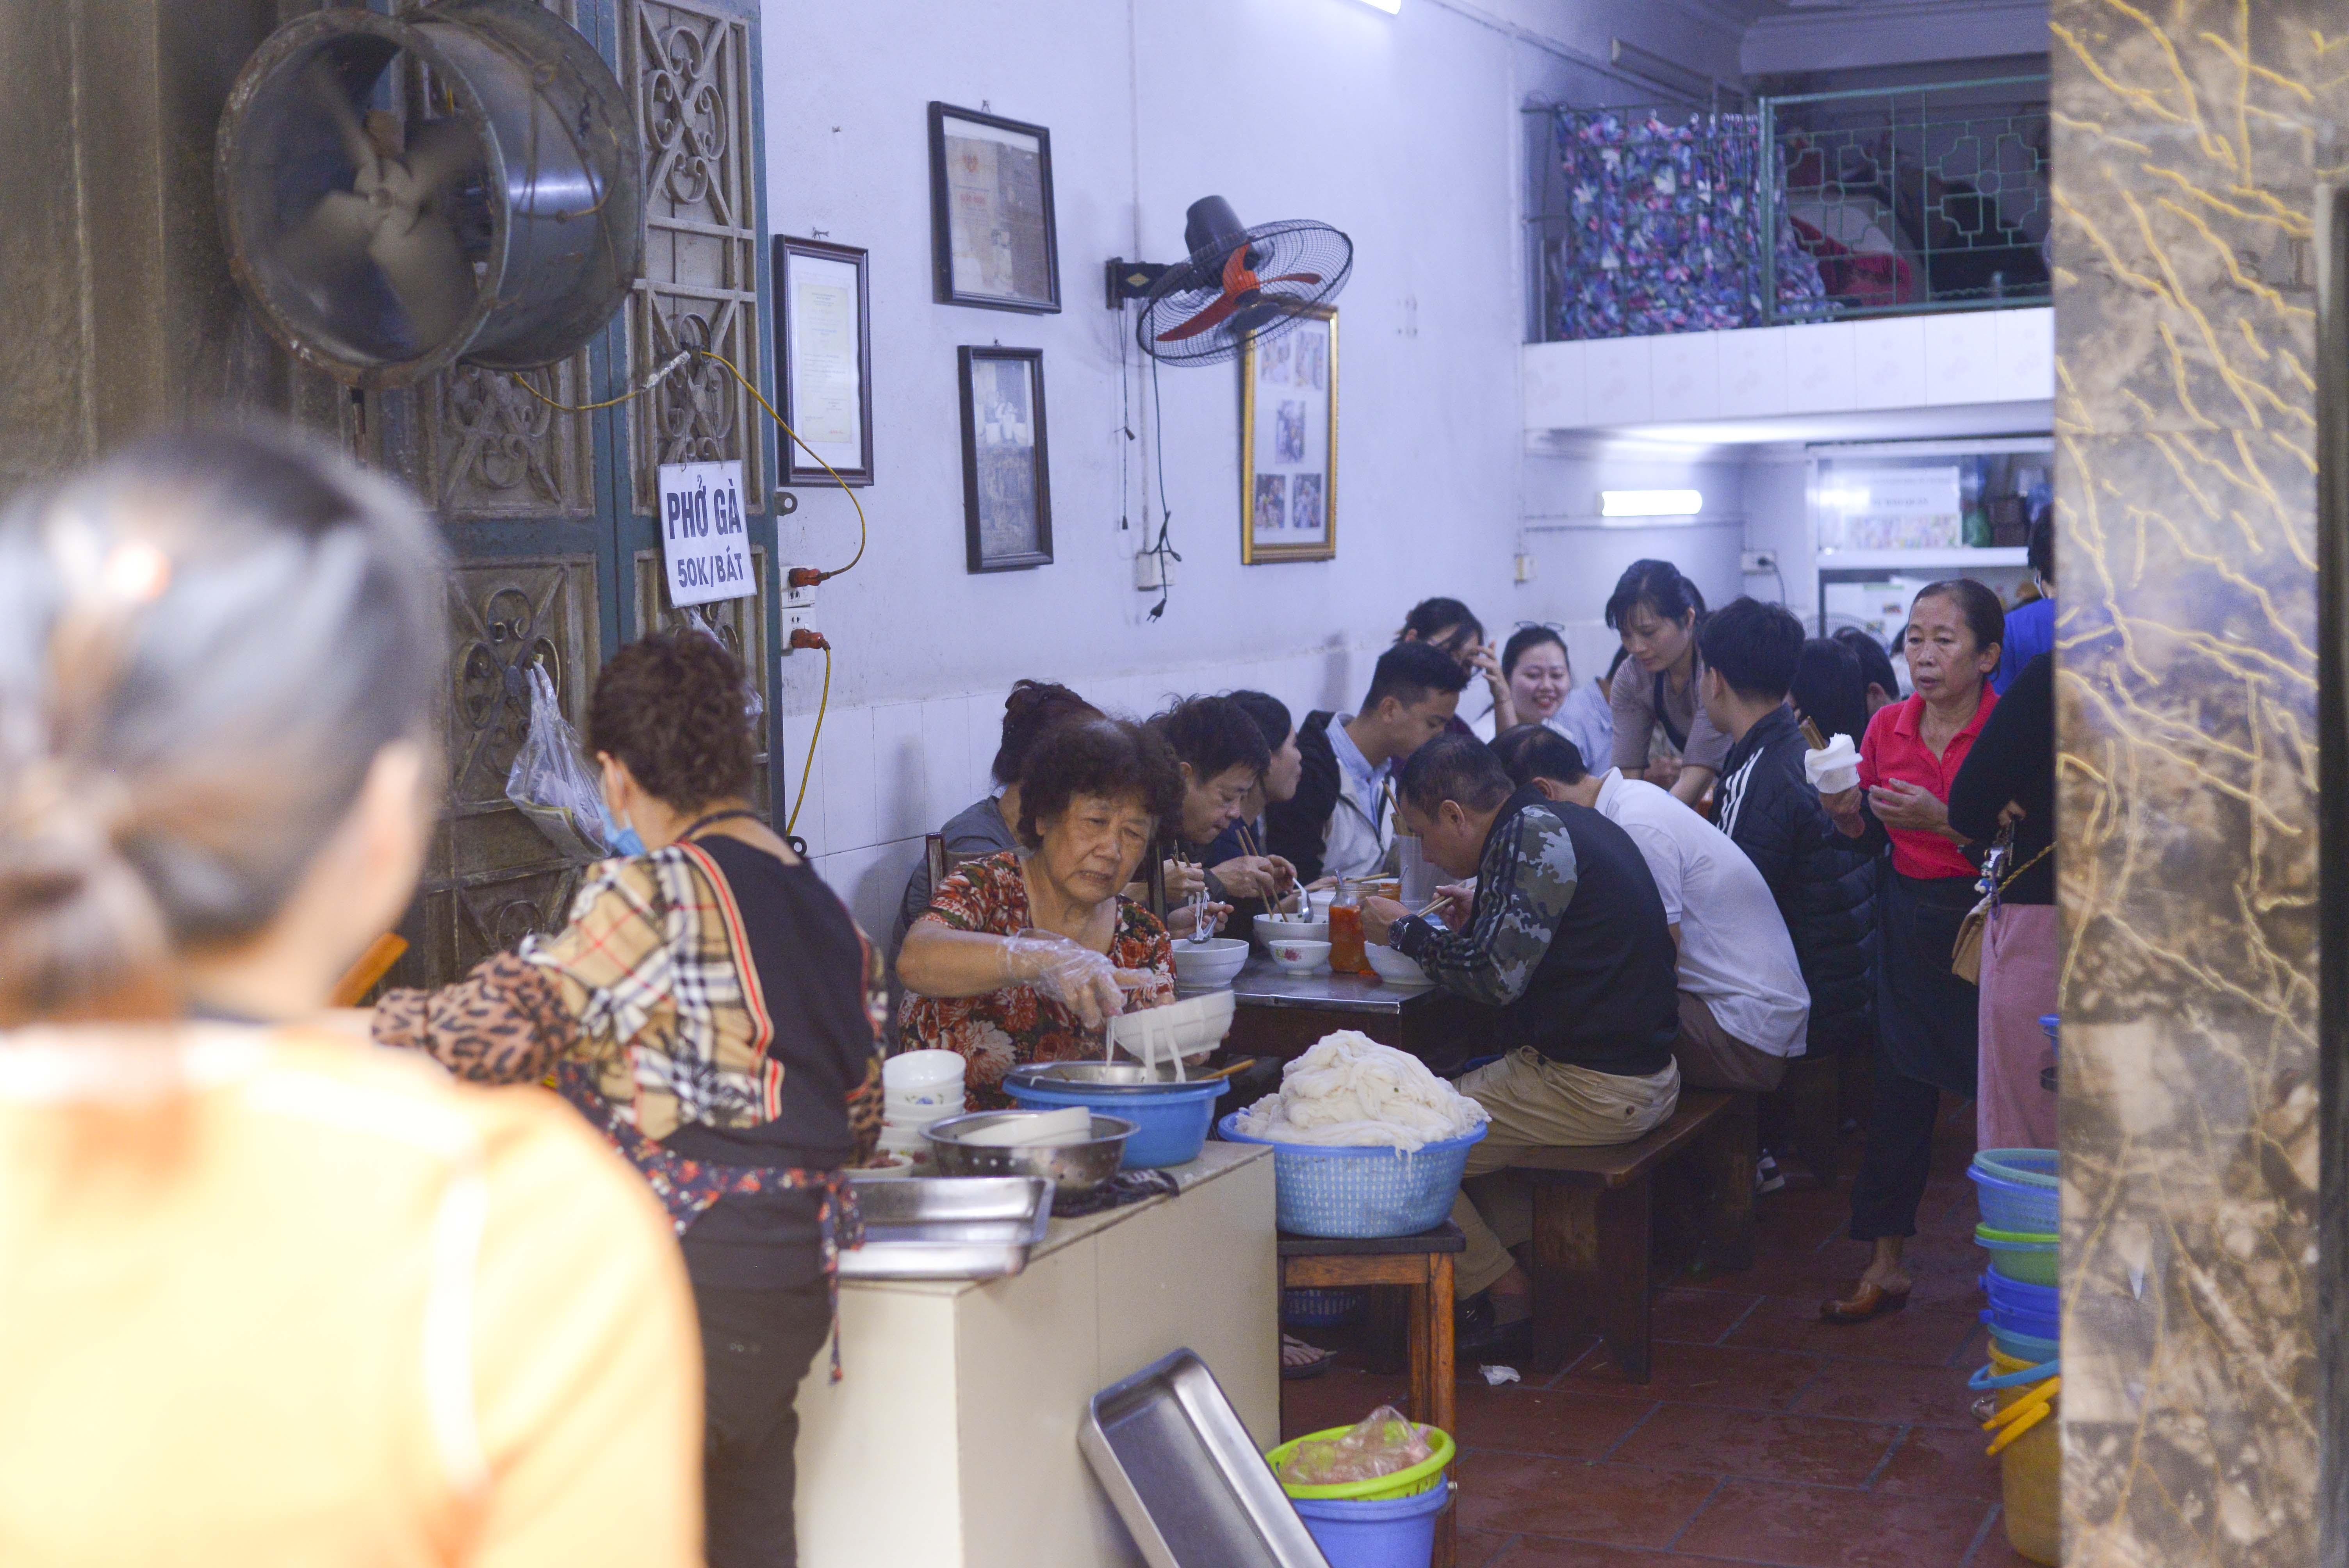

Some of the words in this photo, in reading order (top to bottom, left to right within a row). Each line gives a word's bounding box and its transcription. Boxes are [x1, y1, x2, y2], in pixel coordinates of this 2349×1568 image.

[667, 474, 708, 540] PHỞ
[713, 478, 742, 535] GÀ
[677, 545, 743, 588] 50K/BÁT
